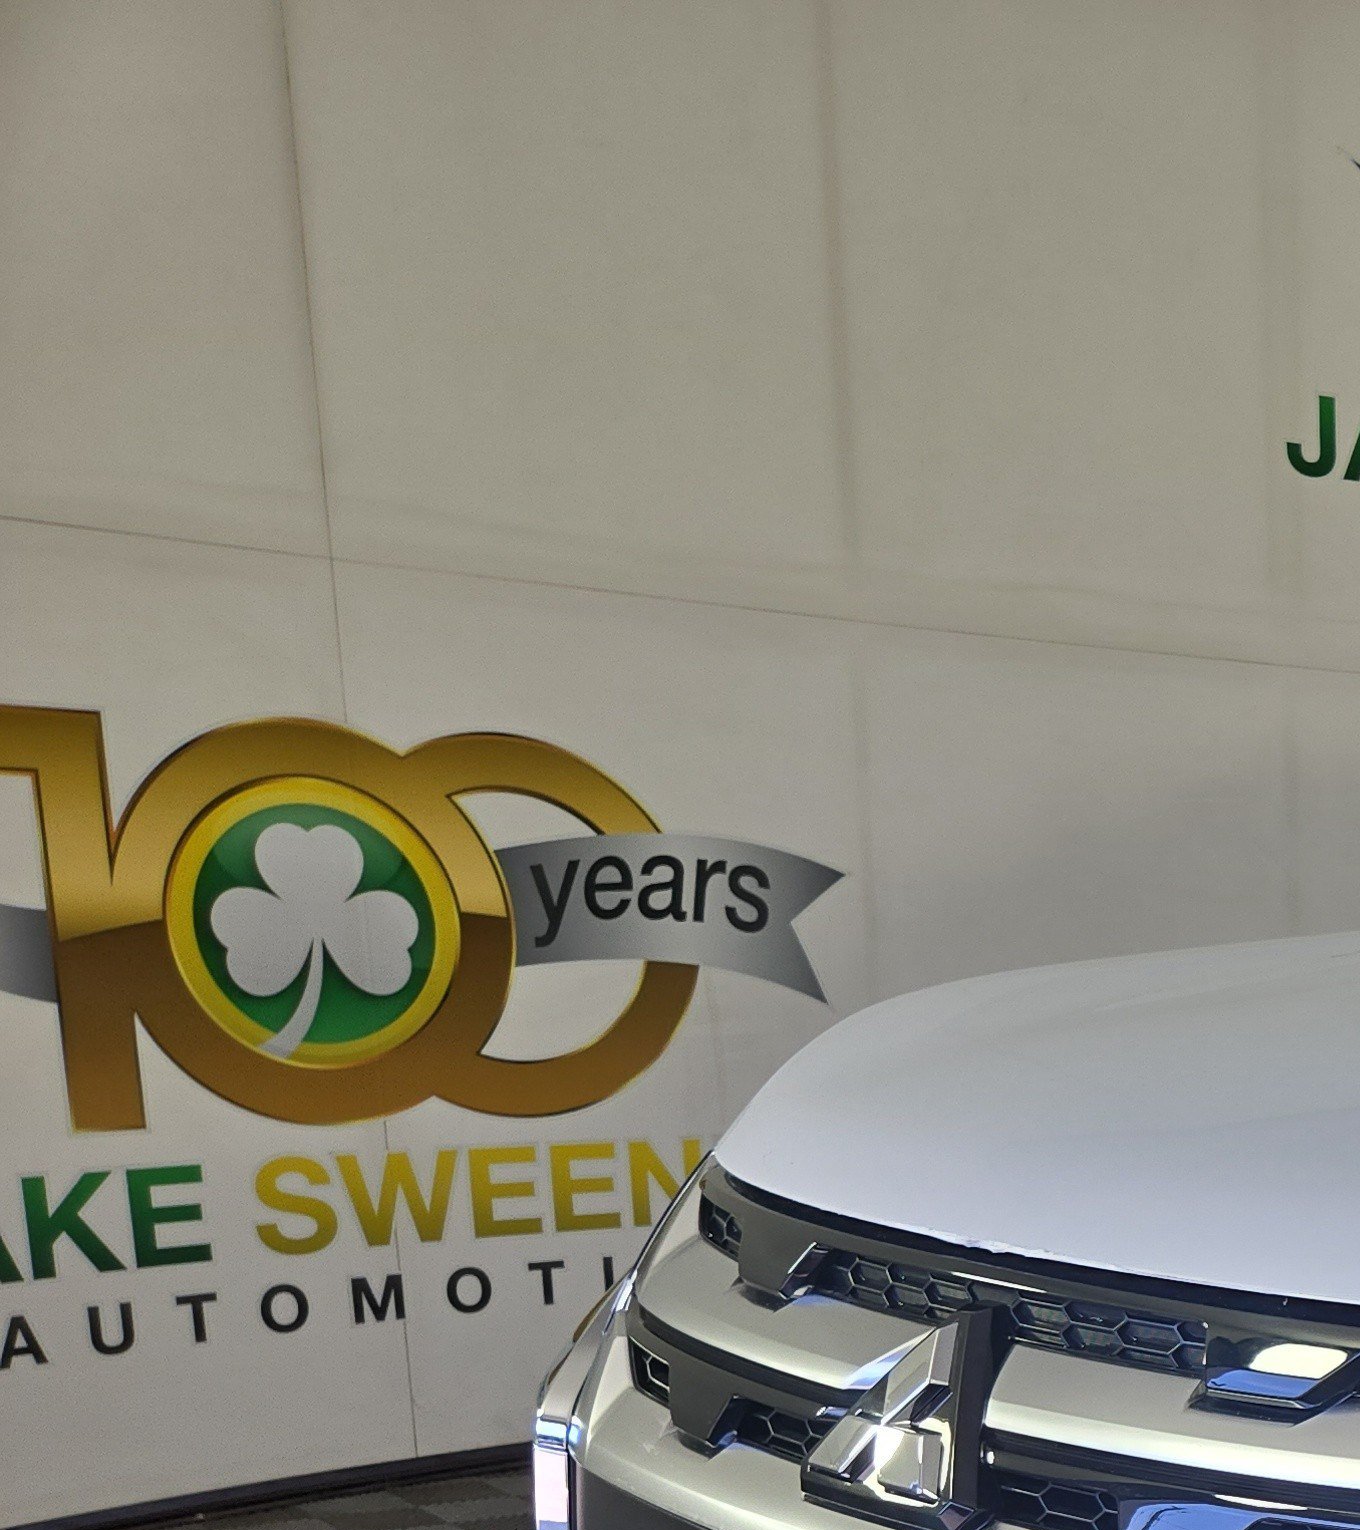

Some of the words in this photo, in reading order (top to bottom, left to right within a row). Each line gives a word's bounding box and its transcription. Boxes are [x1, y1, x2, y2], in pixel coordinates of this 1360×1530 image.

[529, 854, 772, 949] years
[0, 1164, 213, 1283] KE
[254, 1139, 701, 1256] SWEEN
[0, 1256, 615, 1369] AUTOMOTI
